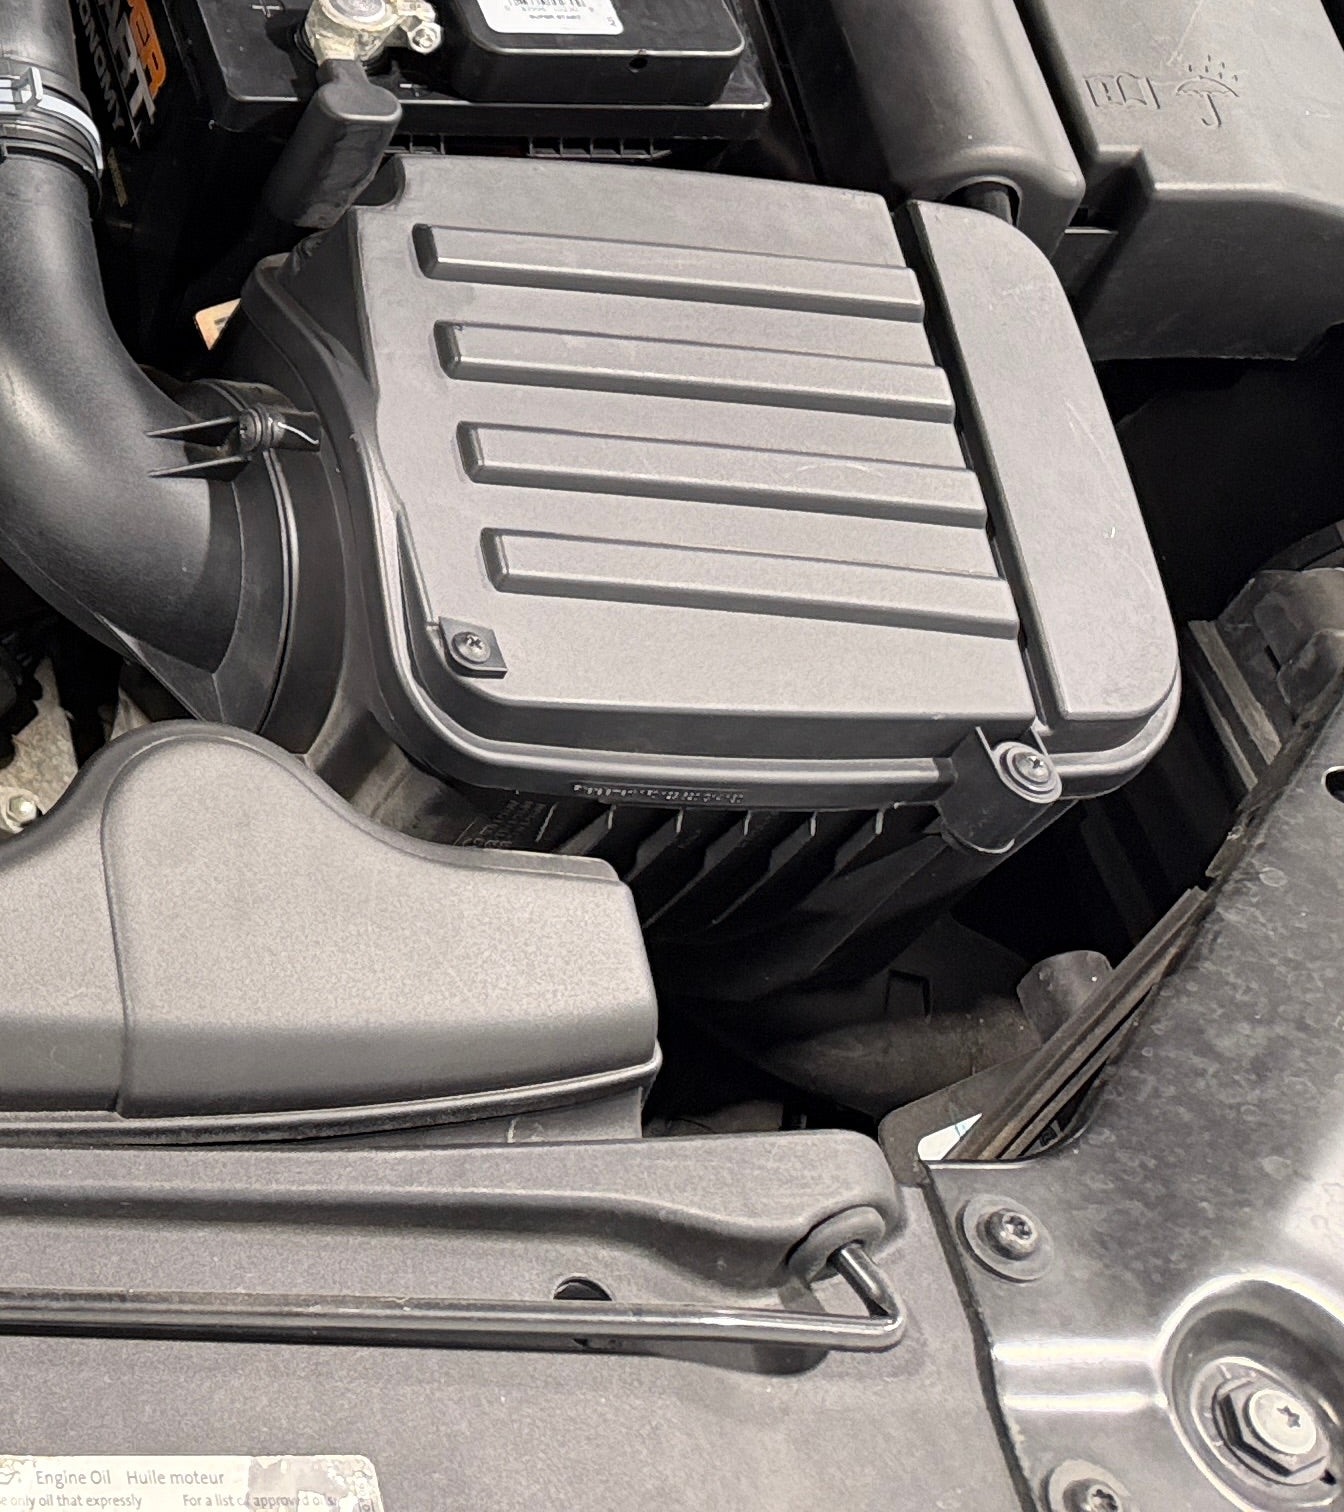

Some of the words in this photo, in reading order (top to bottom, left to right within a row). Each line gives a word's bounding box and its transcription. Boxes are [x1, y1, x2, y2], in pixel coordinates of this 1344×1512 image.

[36, 1470, 87, 1489] Engine
[90, 1470, 111, 1485] Oil
[126, 1470, 166, 1485] Huile
[170, 1471, 224, 1485] moteur
[11, 1494, 35, 1510] only
[39, 1494, 54, 1506] oil
[57, 1494, 83, 1507] that
[86, 1494, 142, 1510] expressly
[183, 1494, 201, 1507] For
[206, 1496, 213, 1507] a
[215, 1494, 235, 1507] list
